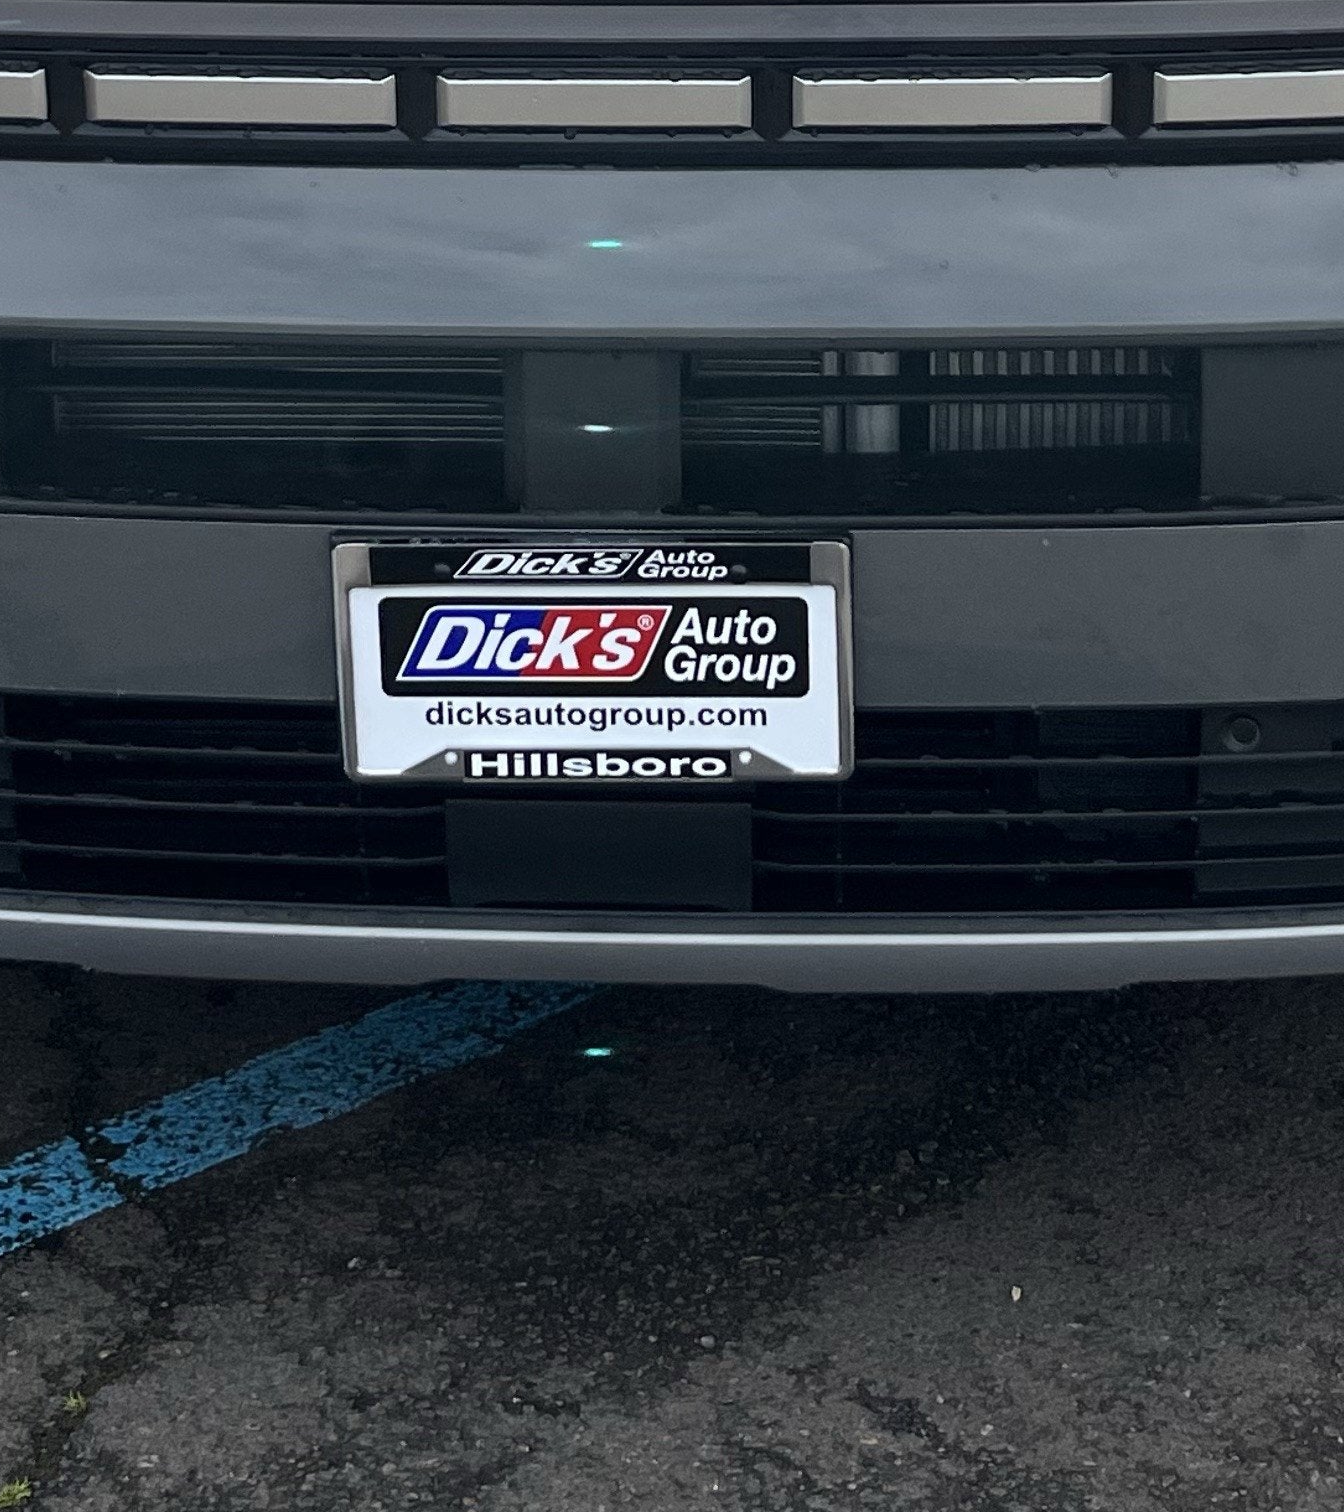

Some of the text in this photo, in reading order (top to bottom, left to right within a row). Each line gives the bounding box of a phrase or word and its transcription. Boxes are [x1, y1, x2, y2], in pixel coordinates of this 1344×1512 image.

[644, 549, 716, 566] Auto
[637, 563, 730, 581] Group
[670, 607, 778, 646] Auto
[664, 646, 797, 690] Group
[424, 701, 768, 732] dicksautogroup.com
[469, 752, 728, 778] Hillsboro
